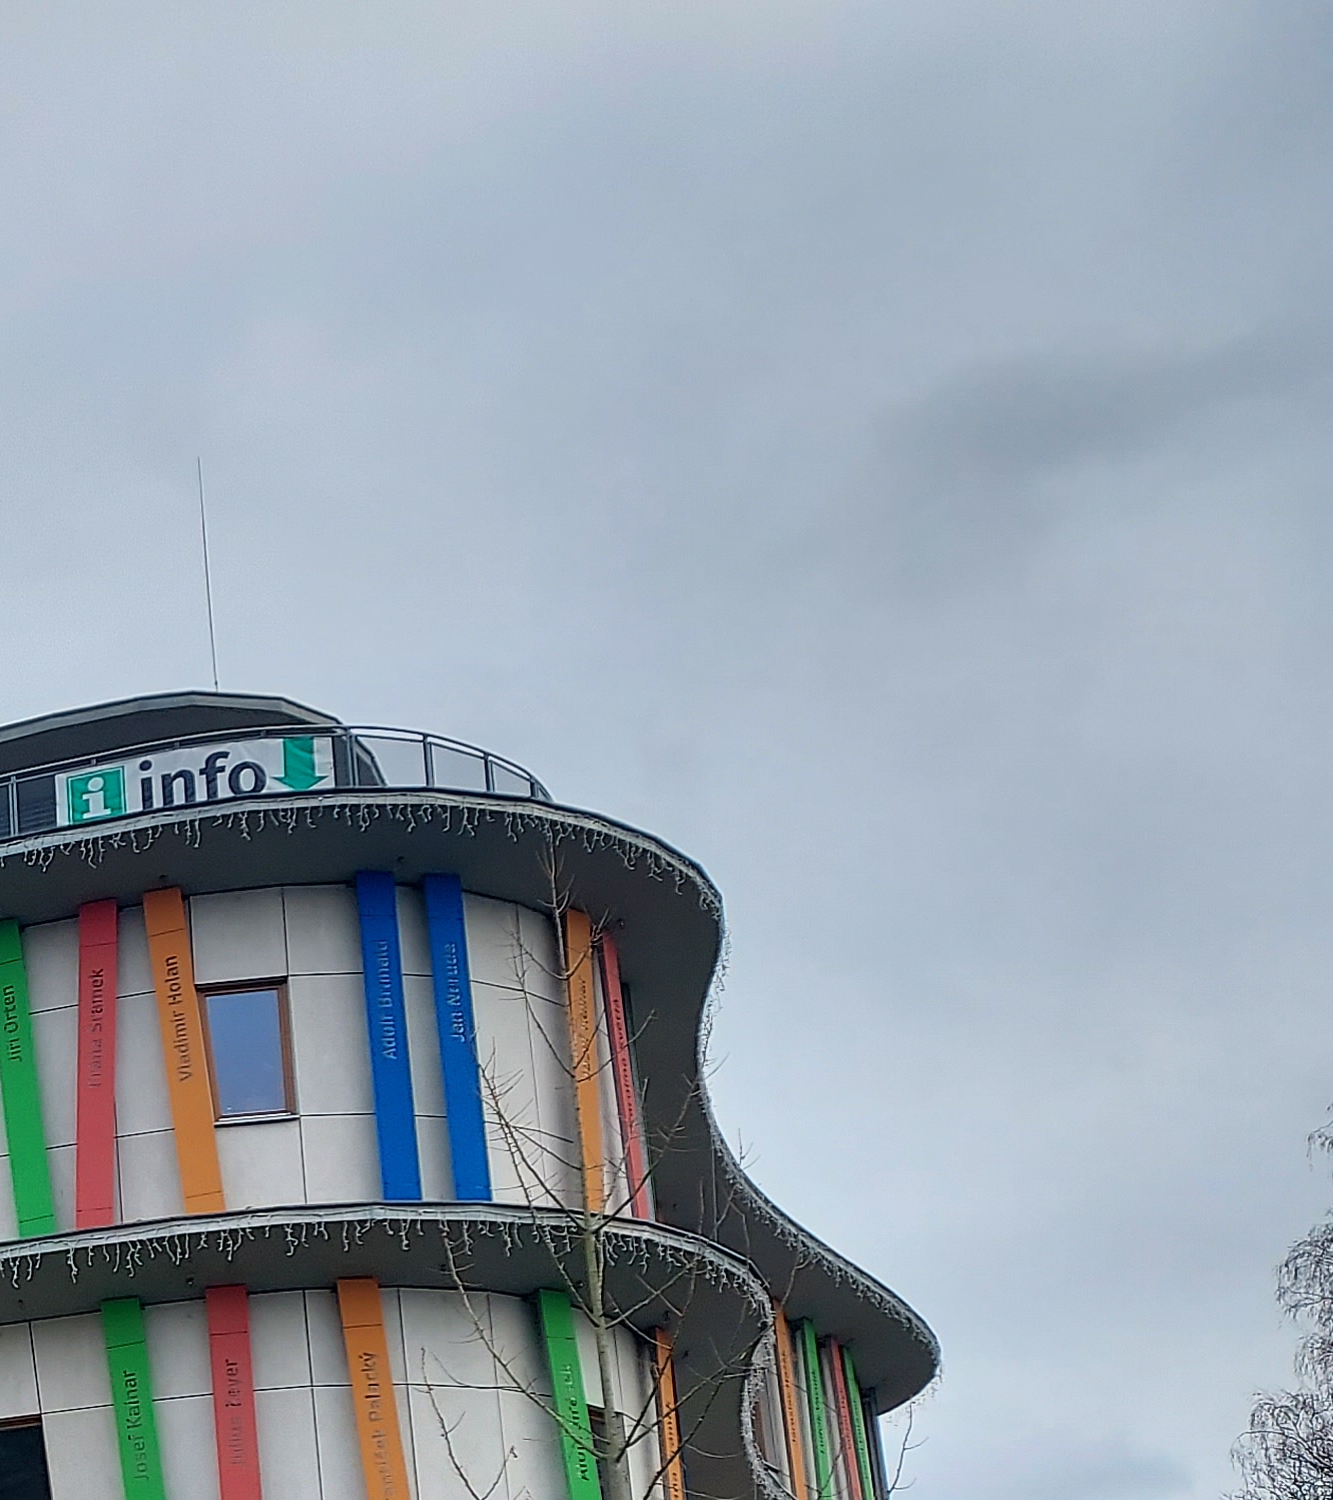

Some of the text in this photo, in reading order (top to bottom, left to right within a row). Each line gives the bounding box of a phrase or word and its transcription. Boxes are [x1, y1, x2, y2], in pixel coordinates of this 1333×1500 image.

[138, 751, 268, 811] info
[163, 954, 182, 1006] Holan
[2, 984, 19, 1034] Orten
[450, 1010, 466, 1043] Jan
[122, 1369, 149, 1481] Josef Kainar
